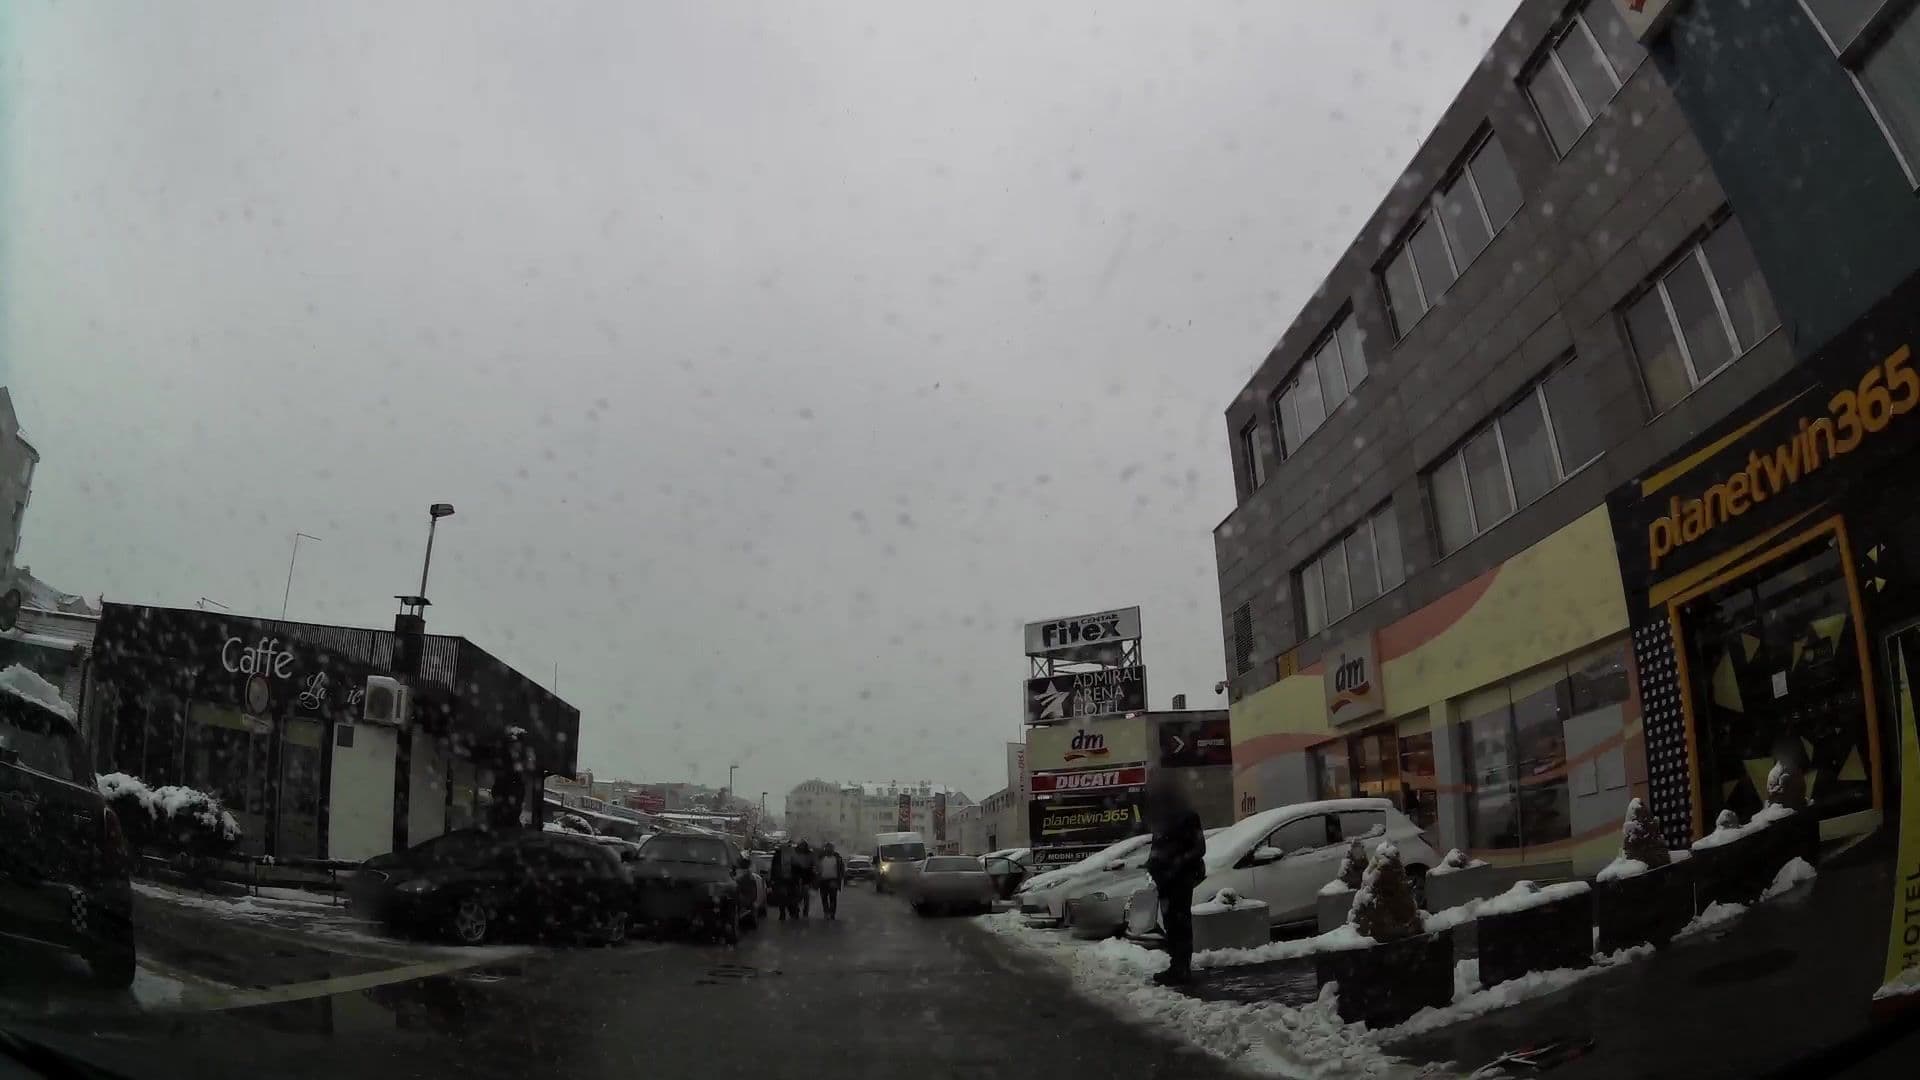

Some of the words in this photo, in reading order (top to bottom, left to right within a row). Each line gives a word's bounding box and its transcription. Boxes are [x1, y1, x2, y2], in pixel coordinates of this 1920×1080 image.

[1648, 343, 1920, 570] planetwin365
[1042, 620, 1121, 648] Fitex
[222, 637, 295, 679] Caffe
[1073, 667, 1141, 688] ADMIRAL
[1335, 653, 1365, 693] dm
[1073, 685, 1125, 702] ARENA
[1073, 699, 1120, 718] HOTEL
[1071, 730, 1104, 751] dm
[1056, 772, 1120, 789] DUCATI
[1241, 792, 1256, 813] dm
[1042, 808, 1129, 829] planetwin365
